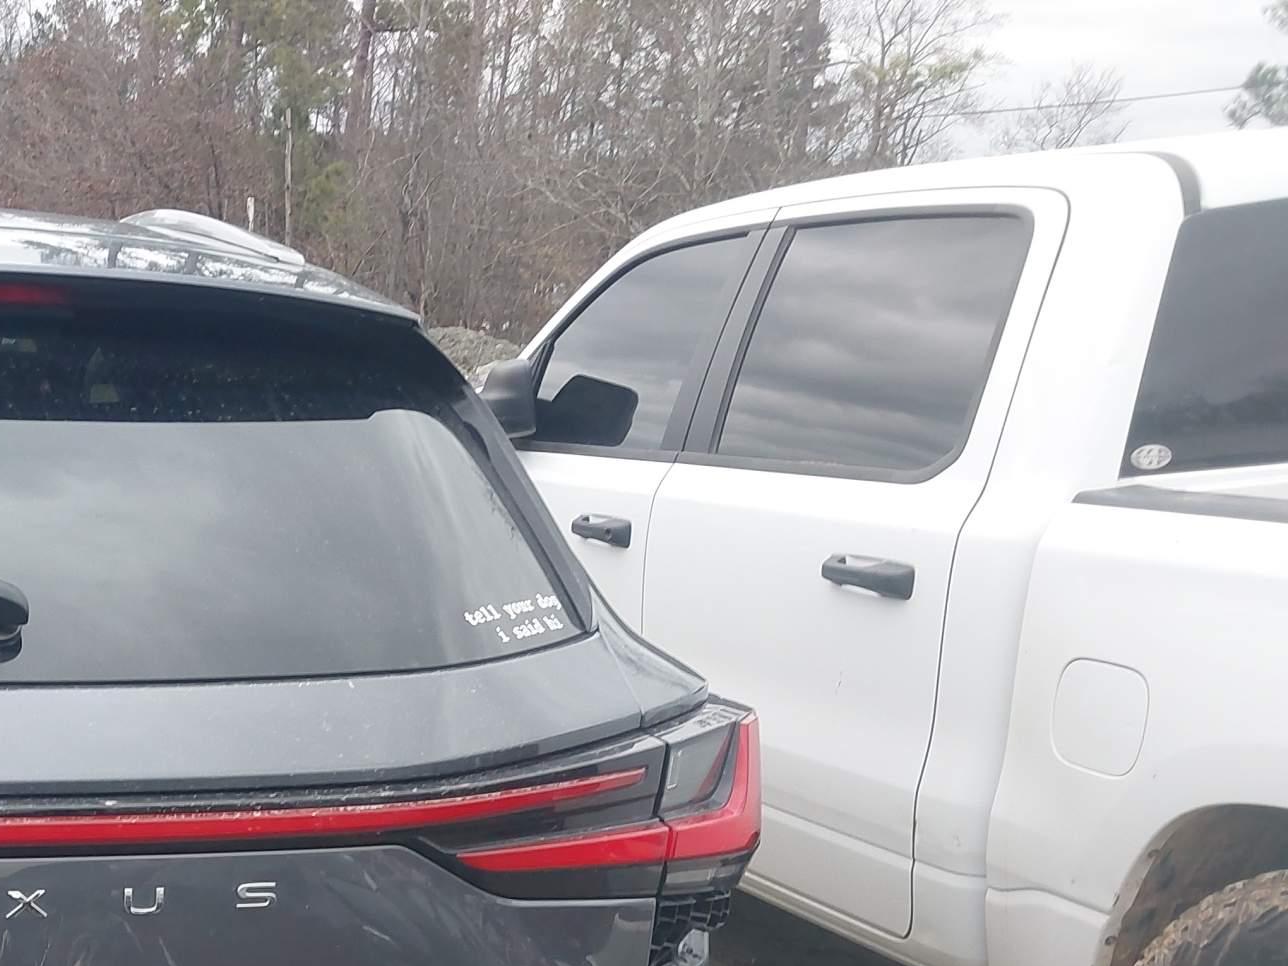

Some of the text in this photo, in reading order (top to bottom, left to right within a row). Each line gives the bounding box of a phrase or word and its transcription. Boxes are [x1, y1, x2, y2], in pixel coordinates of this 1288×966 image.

[464, 593, 562, 626] tell your dog
[496, 613, 564, 643] i said hi
